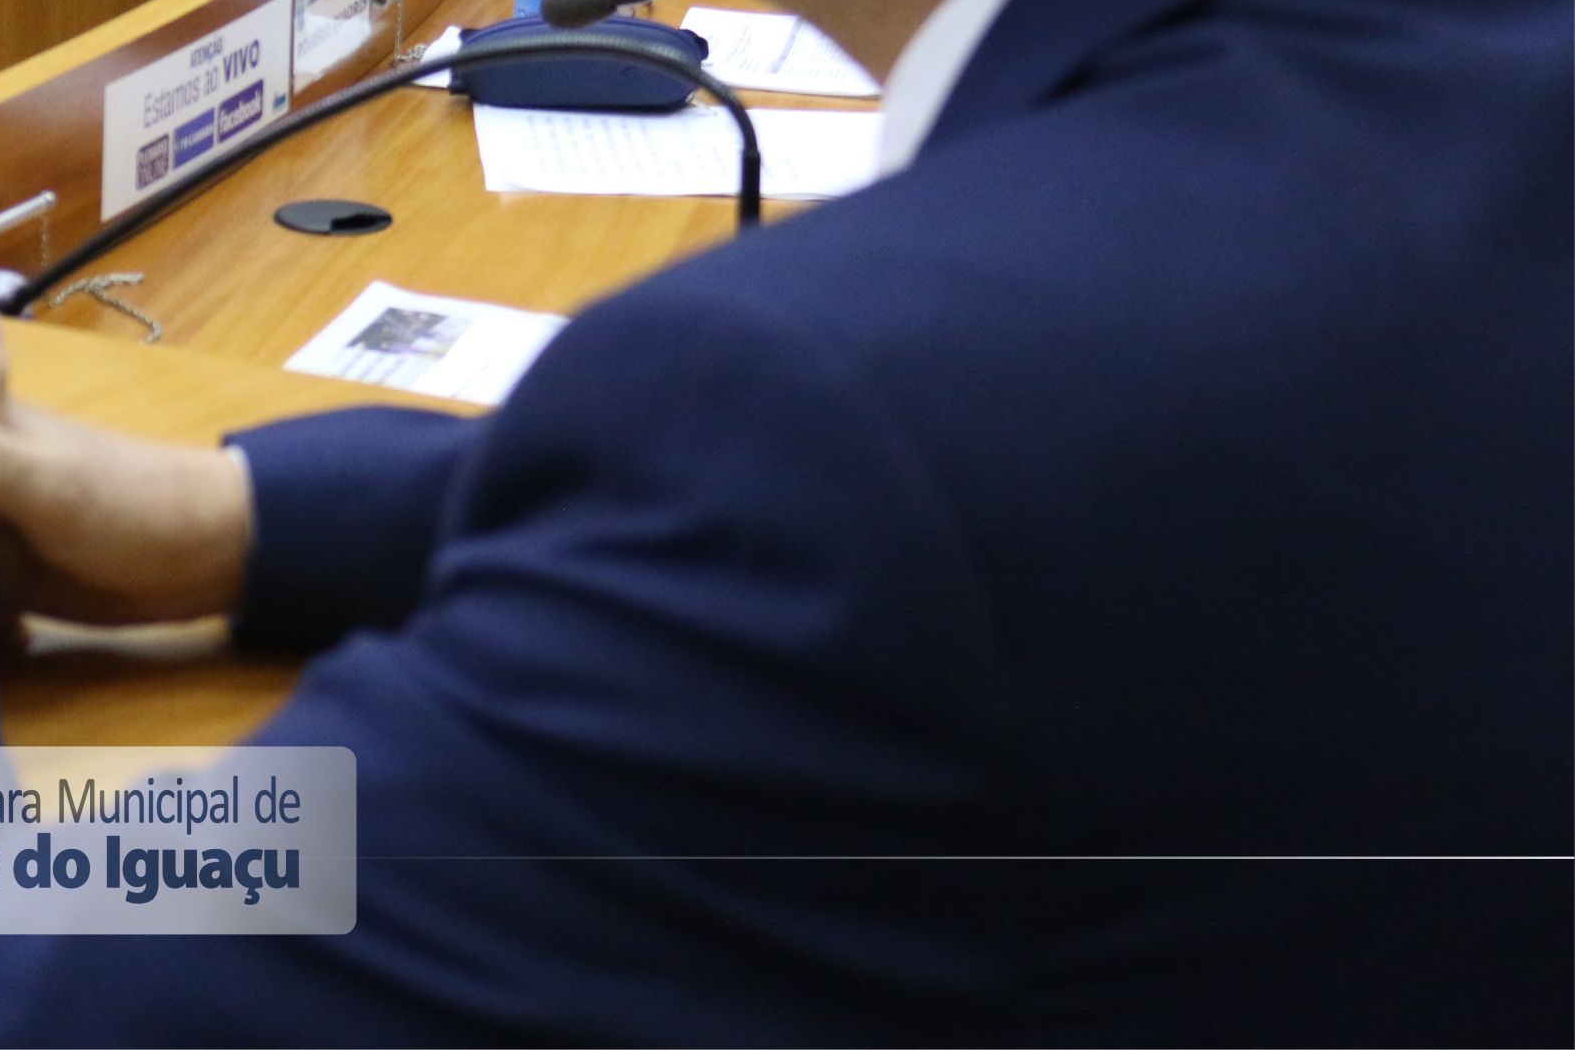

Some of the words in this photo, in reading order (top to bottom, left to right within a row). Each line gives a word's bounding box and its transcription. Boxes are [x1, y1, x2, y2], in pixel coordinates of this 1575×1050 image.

[190, 36, 223, 68] ATENÇÃO
[143, 74, 199, 128] Estamos
[204, 68, 218, 96] ao
[223, 39, 260, 82] VIVO
